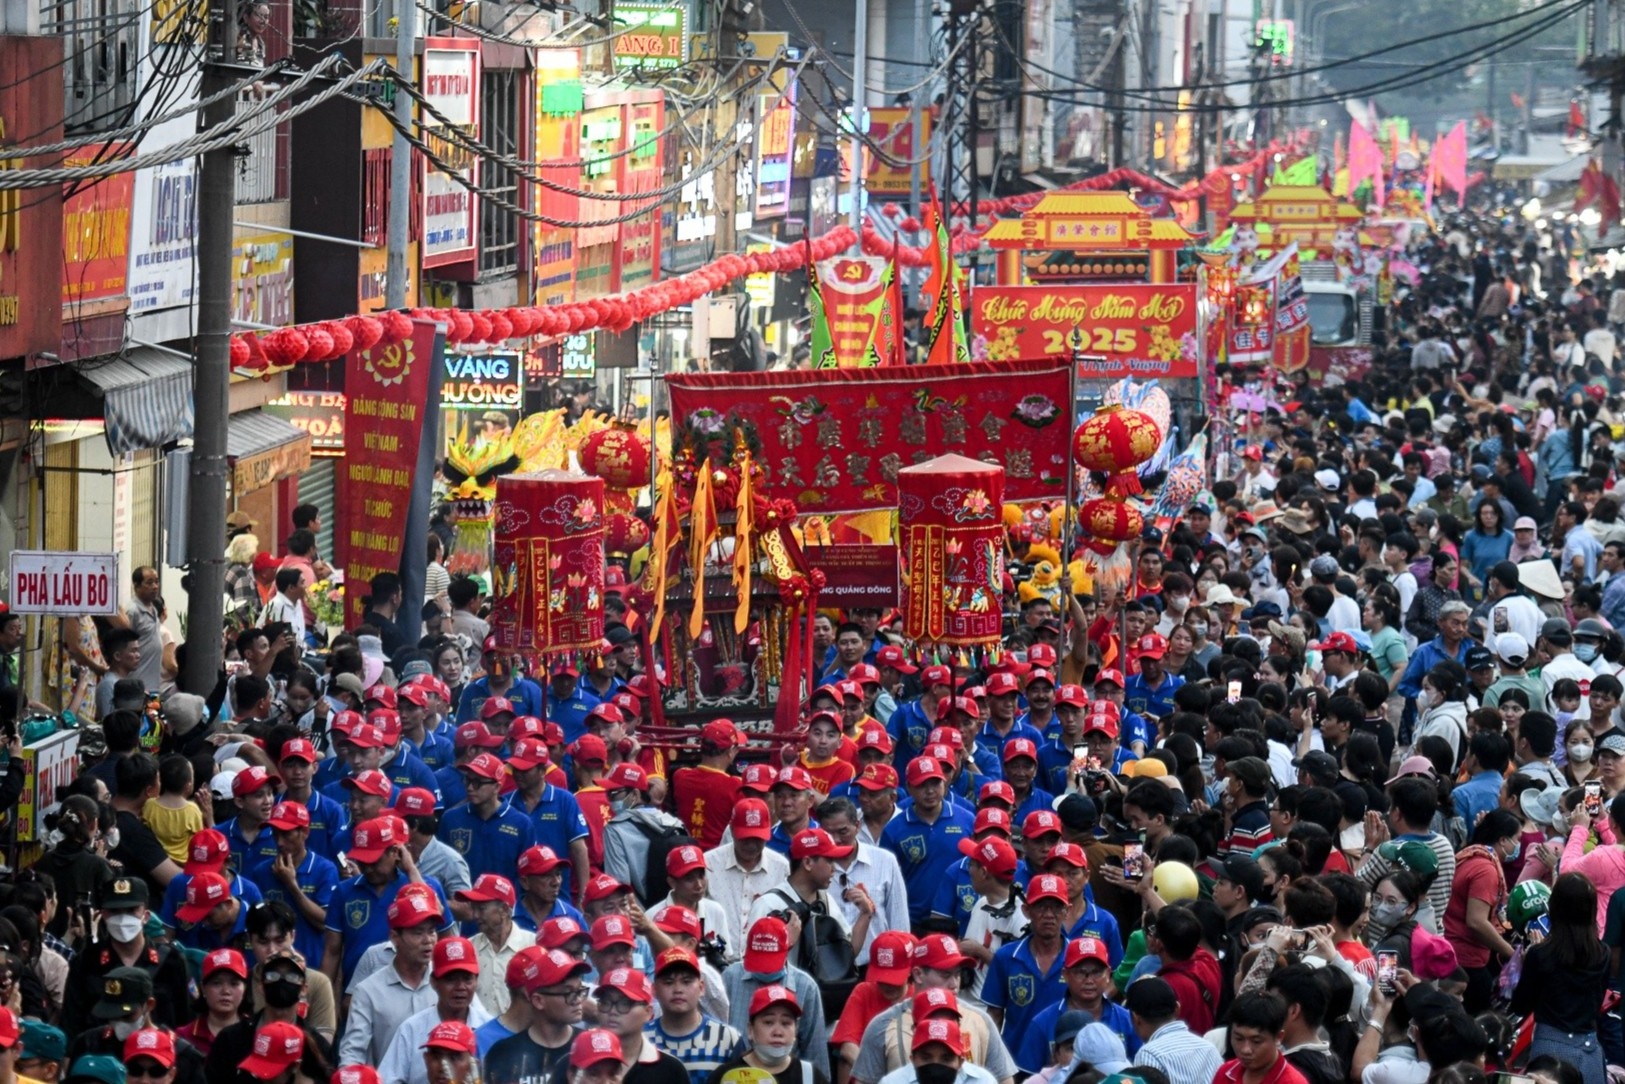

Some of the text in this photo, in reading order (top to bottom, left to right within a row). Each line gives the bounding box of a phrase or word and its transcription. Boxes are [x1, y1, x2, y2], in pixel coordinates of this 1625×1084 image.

[982, 294, 1184, 326] Chúc Mừng Năm Mới
[1042, 327, 1137, 354] 2025
[353, 394, 377, 417] ĐẢNG
[379, 434, 398, 452] NAM
[17, 561, 108, 607] PHÁ LẤU BÒ
[836, 584, 863, 595] QUẢNG
[866, 584, 892, 594] ĐÔNG
